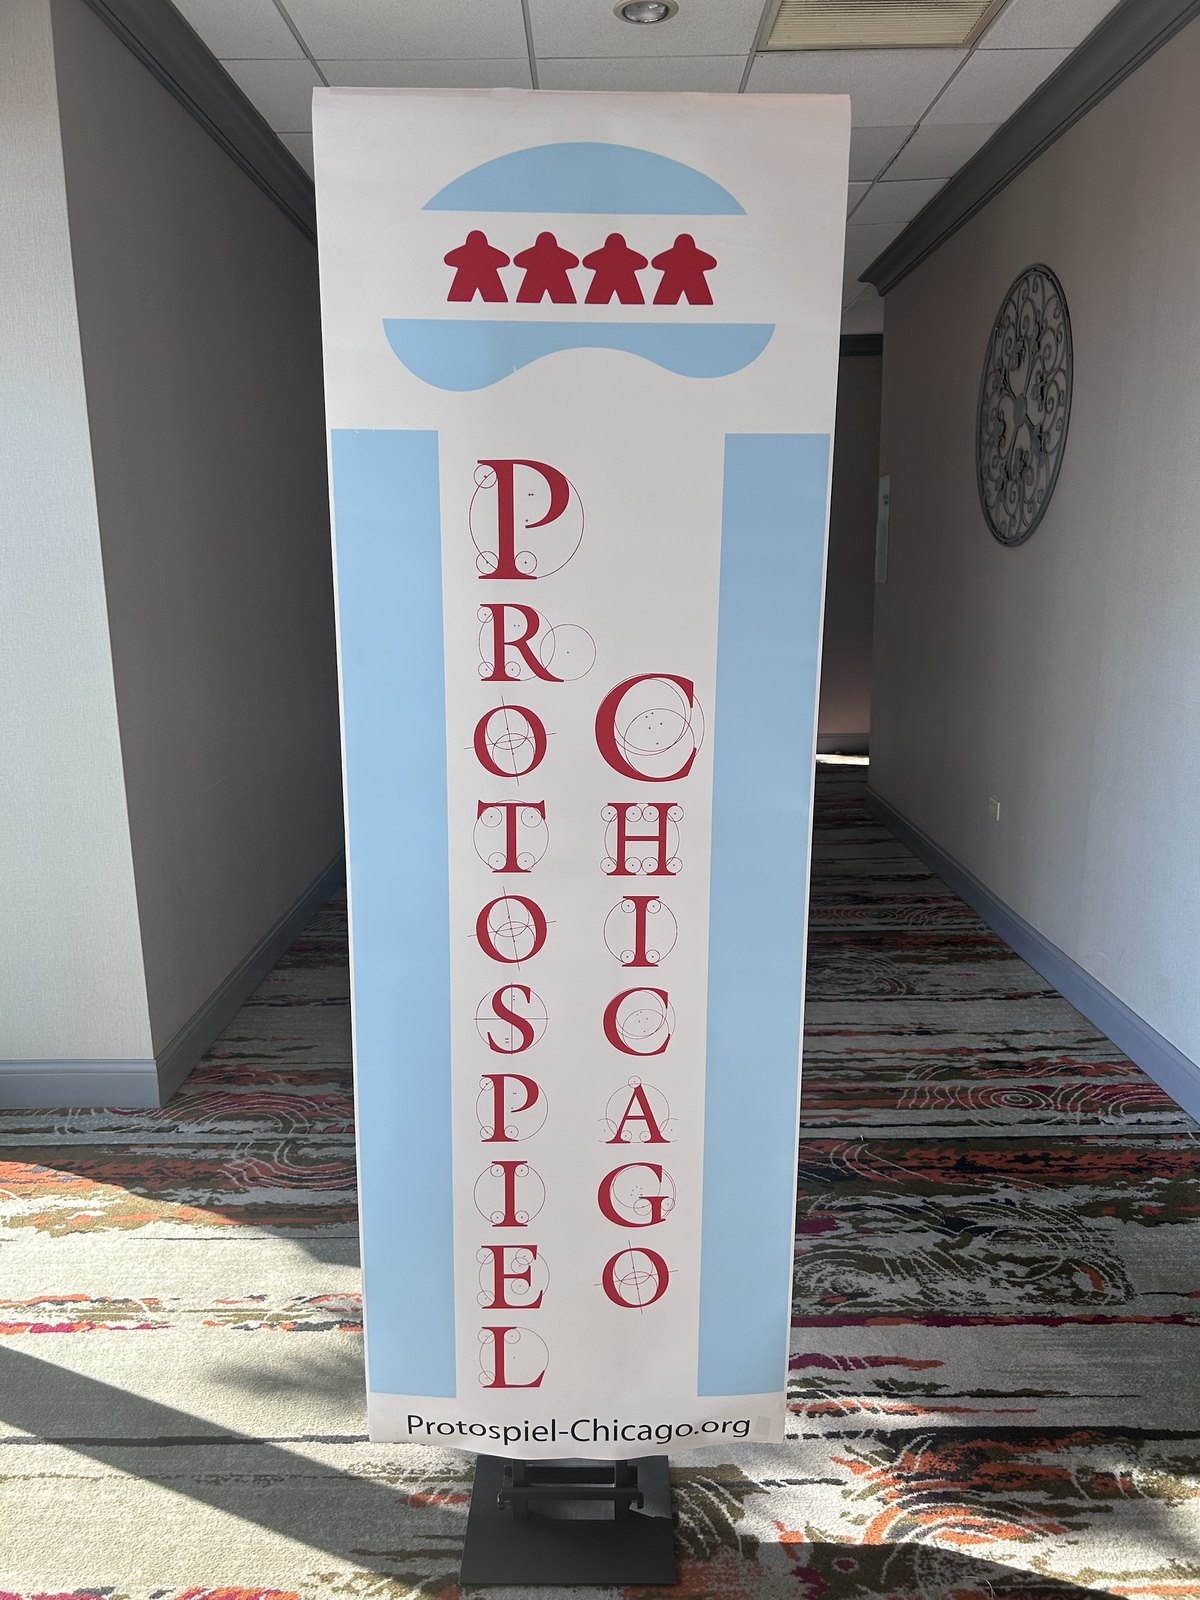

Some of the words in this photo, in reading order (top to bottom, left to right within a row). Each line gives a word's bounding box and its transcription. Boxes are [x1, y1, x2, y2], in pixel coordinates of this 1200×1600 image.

[473, 459, 570, 1388] PROTOSPIEL
[595, 673, 698, 1308] CHICAGO
[407, 1414, 751, 1446] Protospiel-Chicago.org
